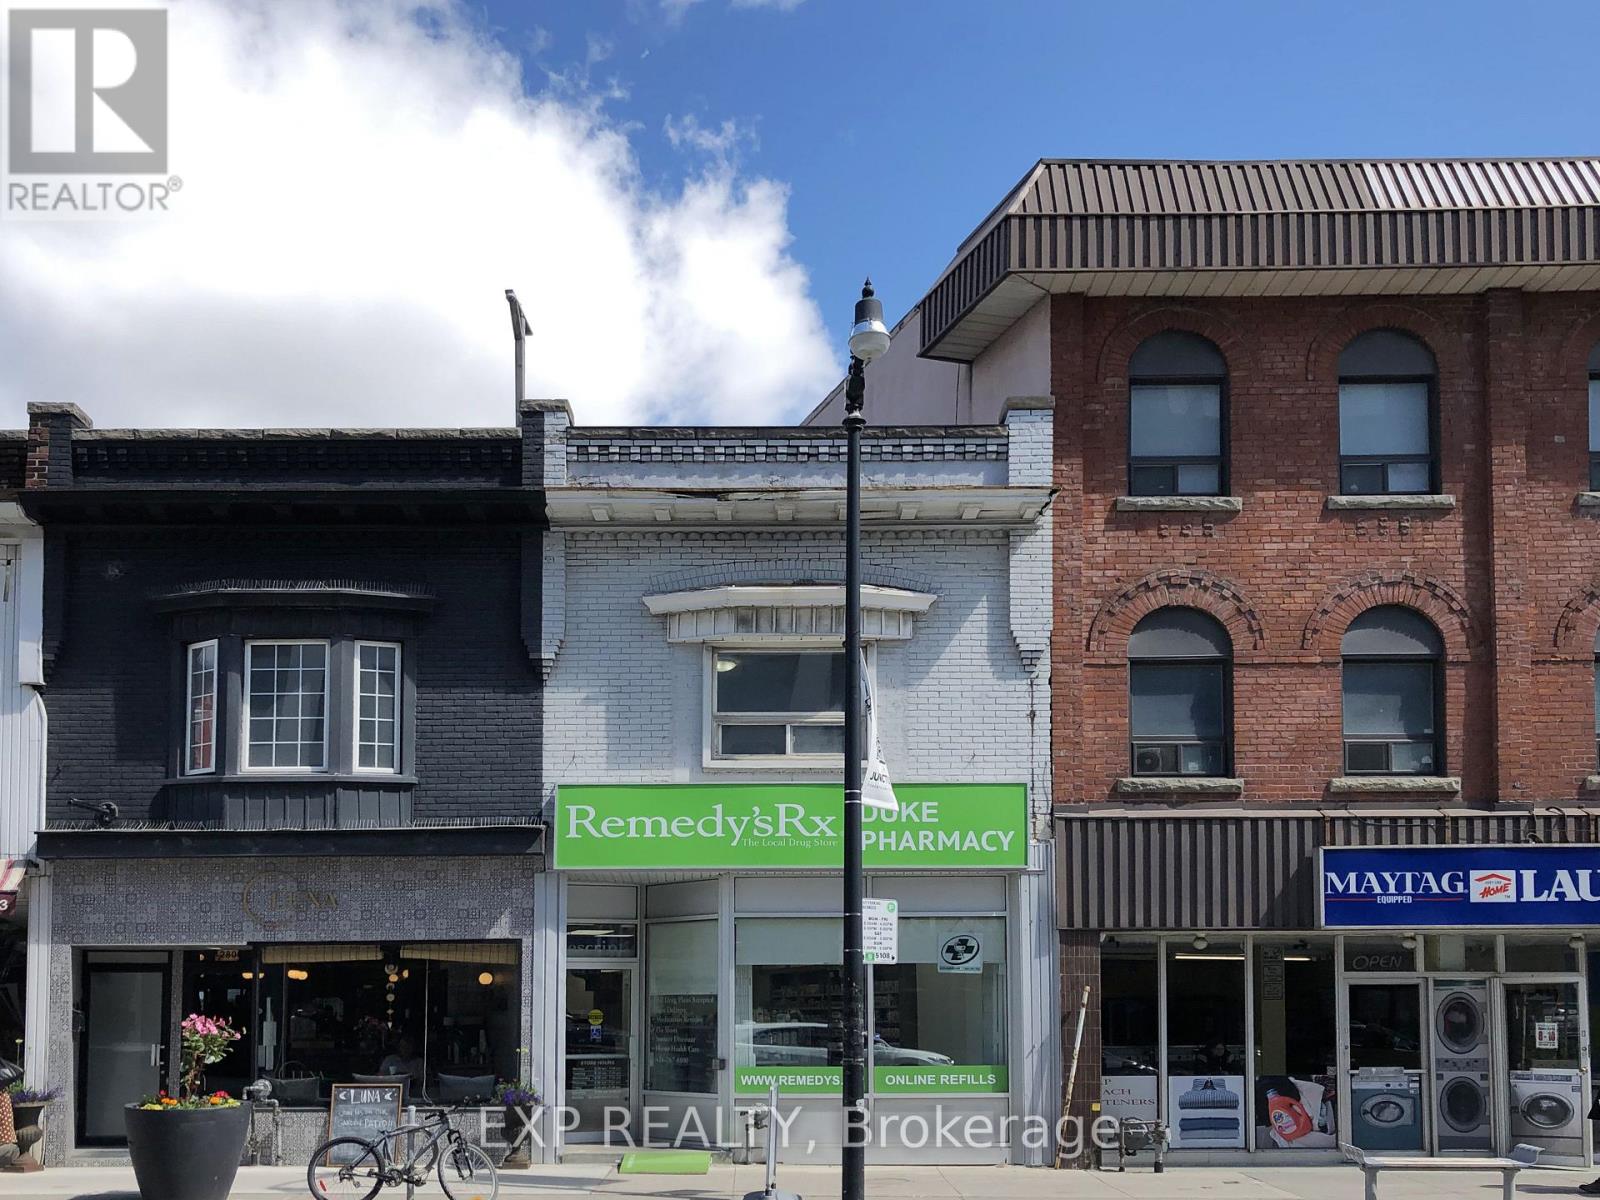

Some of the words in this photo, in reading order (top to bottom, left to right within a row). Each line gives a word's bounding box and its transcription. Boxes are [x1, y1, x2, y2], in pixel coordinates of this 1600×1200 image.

[862, 801, 939, 823] DUKE
[742, 838, 760, 847] The
[762, 838, 786, 847] Local
[789, 838, 812, 849] Drug
[814, 838, 838, 847] Store
[862, 830, 1015, 852] PHARMACY
[1479, 883, 1512, 899] HOME
[1377, 895, 1413, 904] EQUIPPED
[1352, 955, 1402, 971] OPEN
[740, 1075, 844, 1086] WWWREMEDYS.
[885, 1074, 936, 1086] ONLINE
[940, 1073, 997, 1085] REFILLS
[350, 1089, 381, 1104] LUNA
